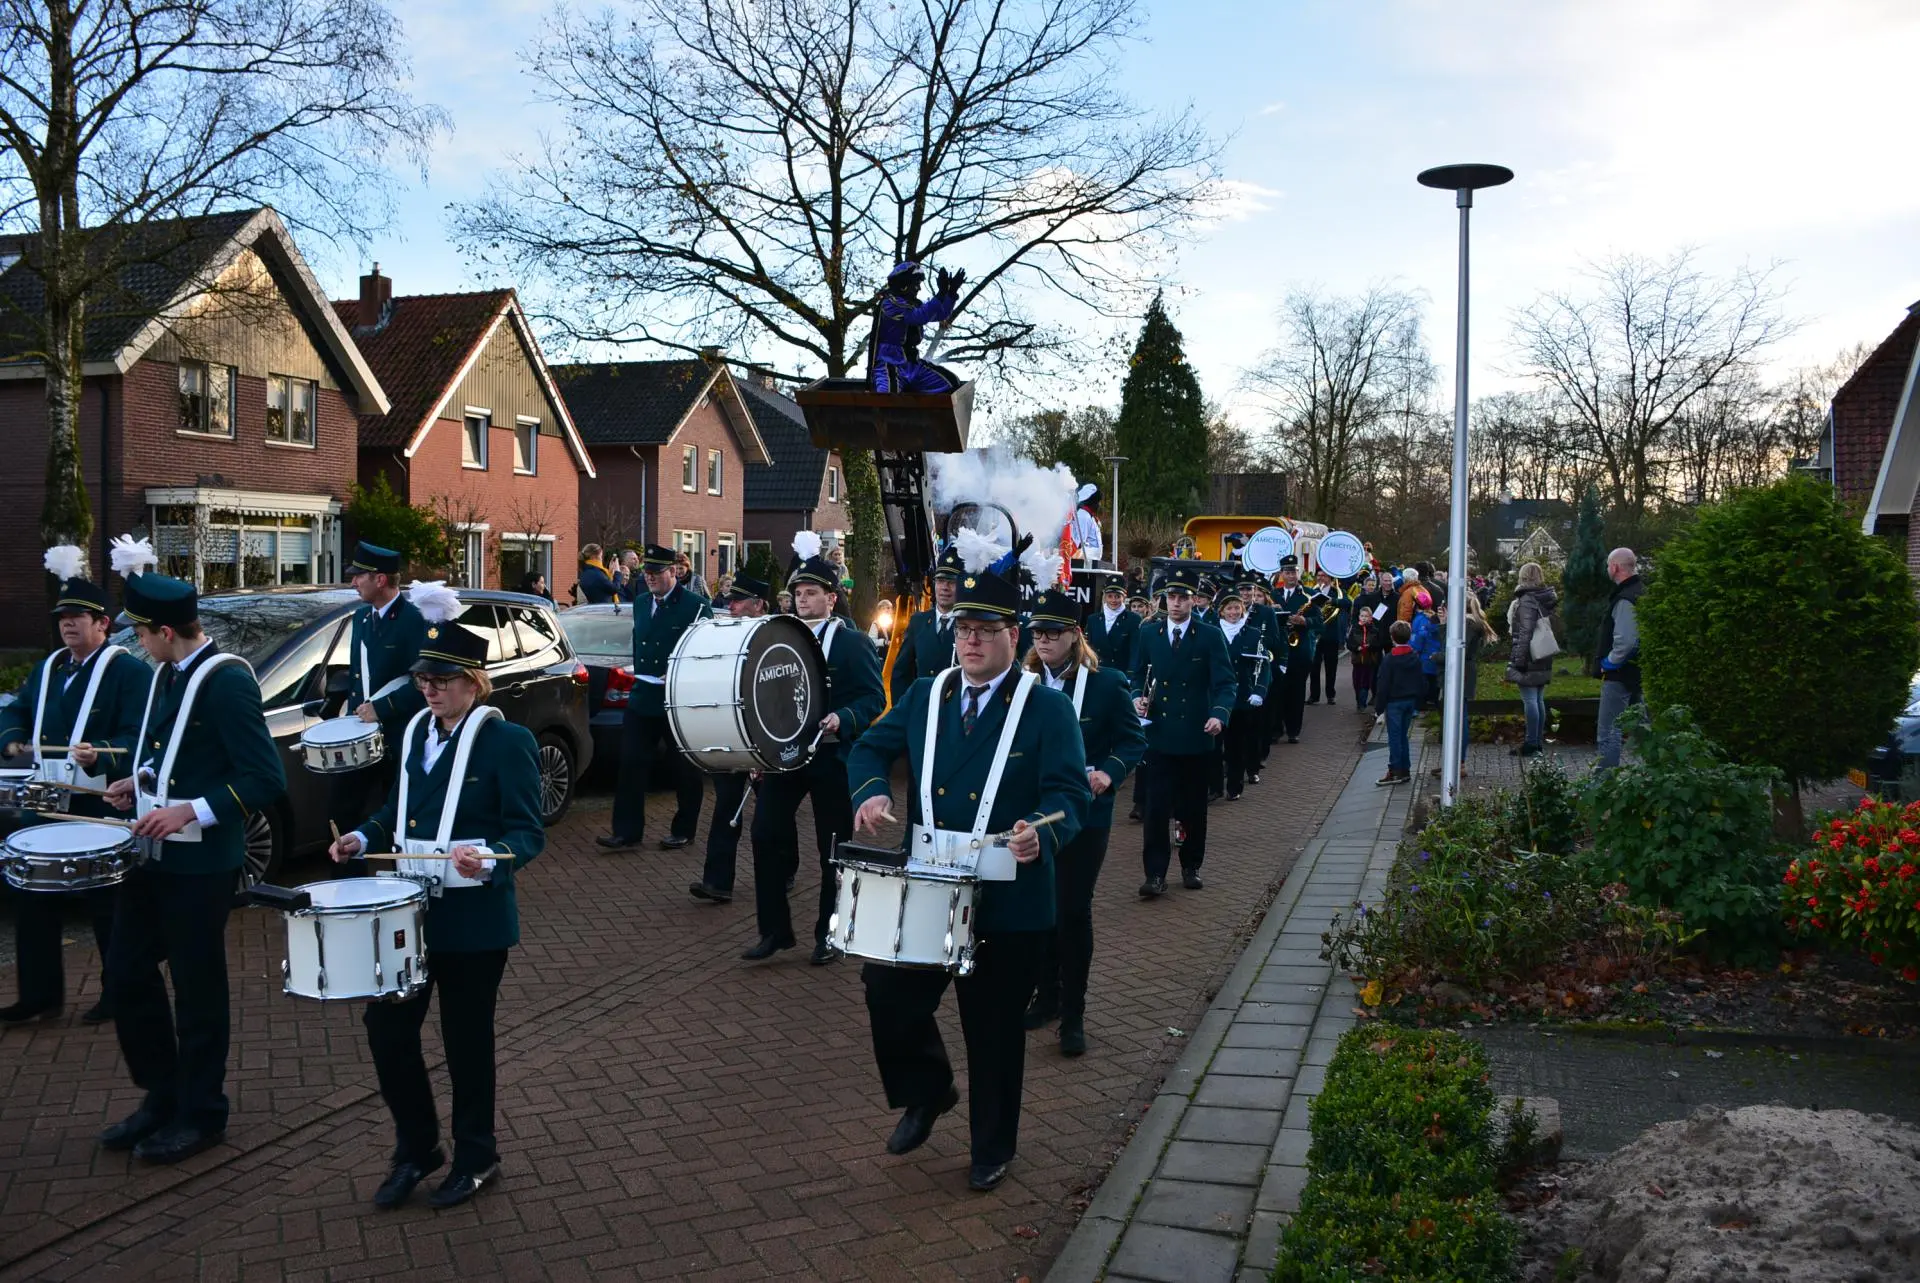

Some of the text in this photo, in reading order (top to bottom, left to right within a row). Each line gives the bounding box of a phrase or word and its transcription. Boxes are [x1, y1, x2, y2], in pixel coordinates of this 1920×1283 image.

[1255, 535, 1286, 545] AMICITIA
[1325, 541, 1357, 550] AMICITIA
[759, 662, 799, 683] AMICITIA
